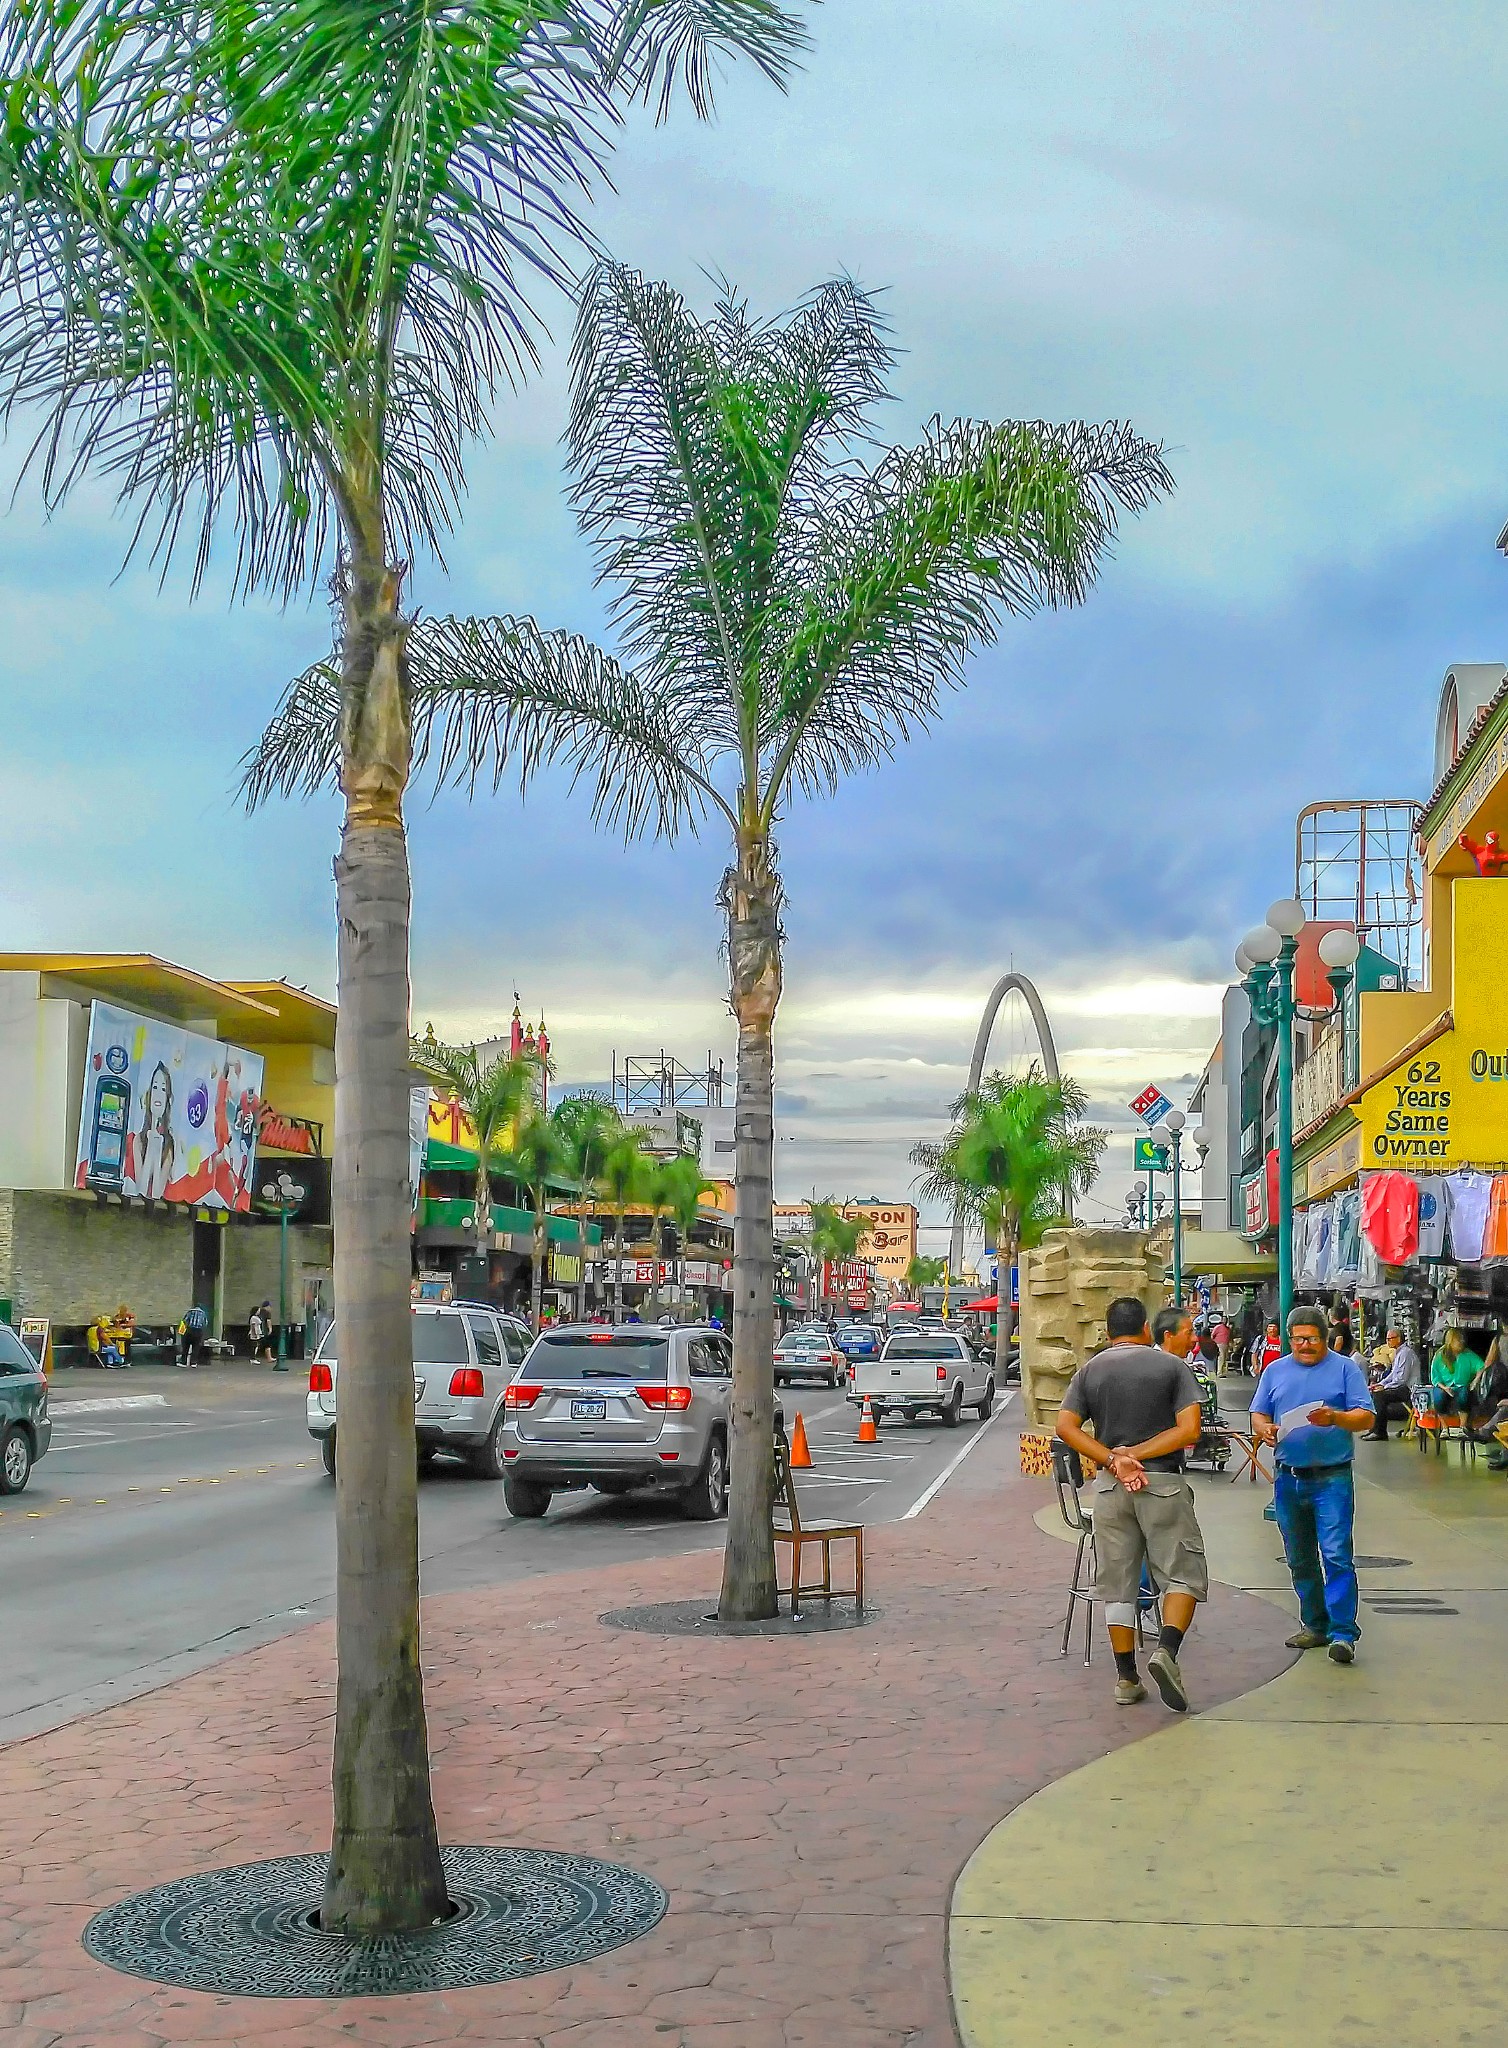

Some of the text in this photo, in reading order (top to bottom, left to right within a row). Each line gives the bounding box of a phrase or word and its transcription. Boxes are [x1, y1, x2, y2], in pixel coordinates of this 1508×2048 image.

[1407, 1061, 1441, 1083] 62
[1393, 1086, 1452, 1108] Years
[189, 1103, 202, 1124] 33
[1385, 1110, 1449, 1132] Same
[1373, 1134, 1451, 1156] Owner
[845, 1211, 906, 1224] ESON
[872, 1231, 908, 1250] Bar
[830, 1260, 865, 1277] COUNT
[857, 1256, 906, 1264] TAURANT
